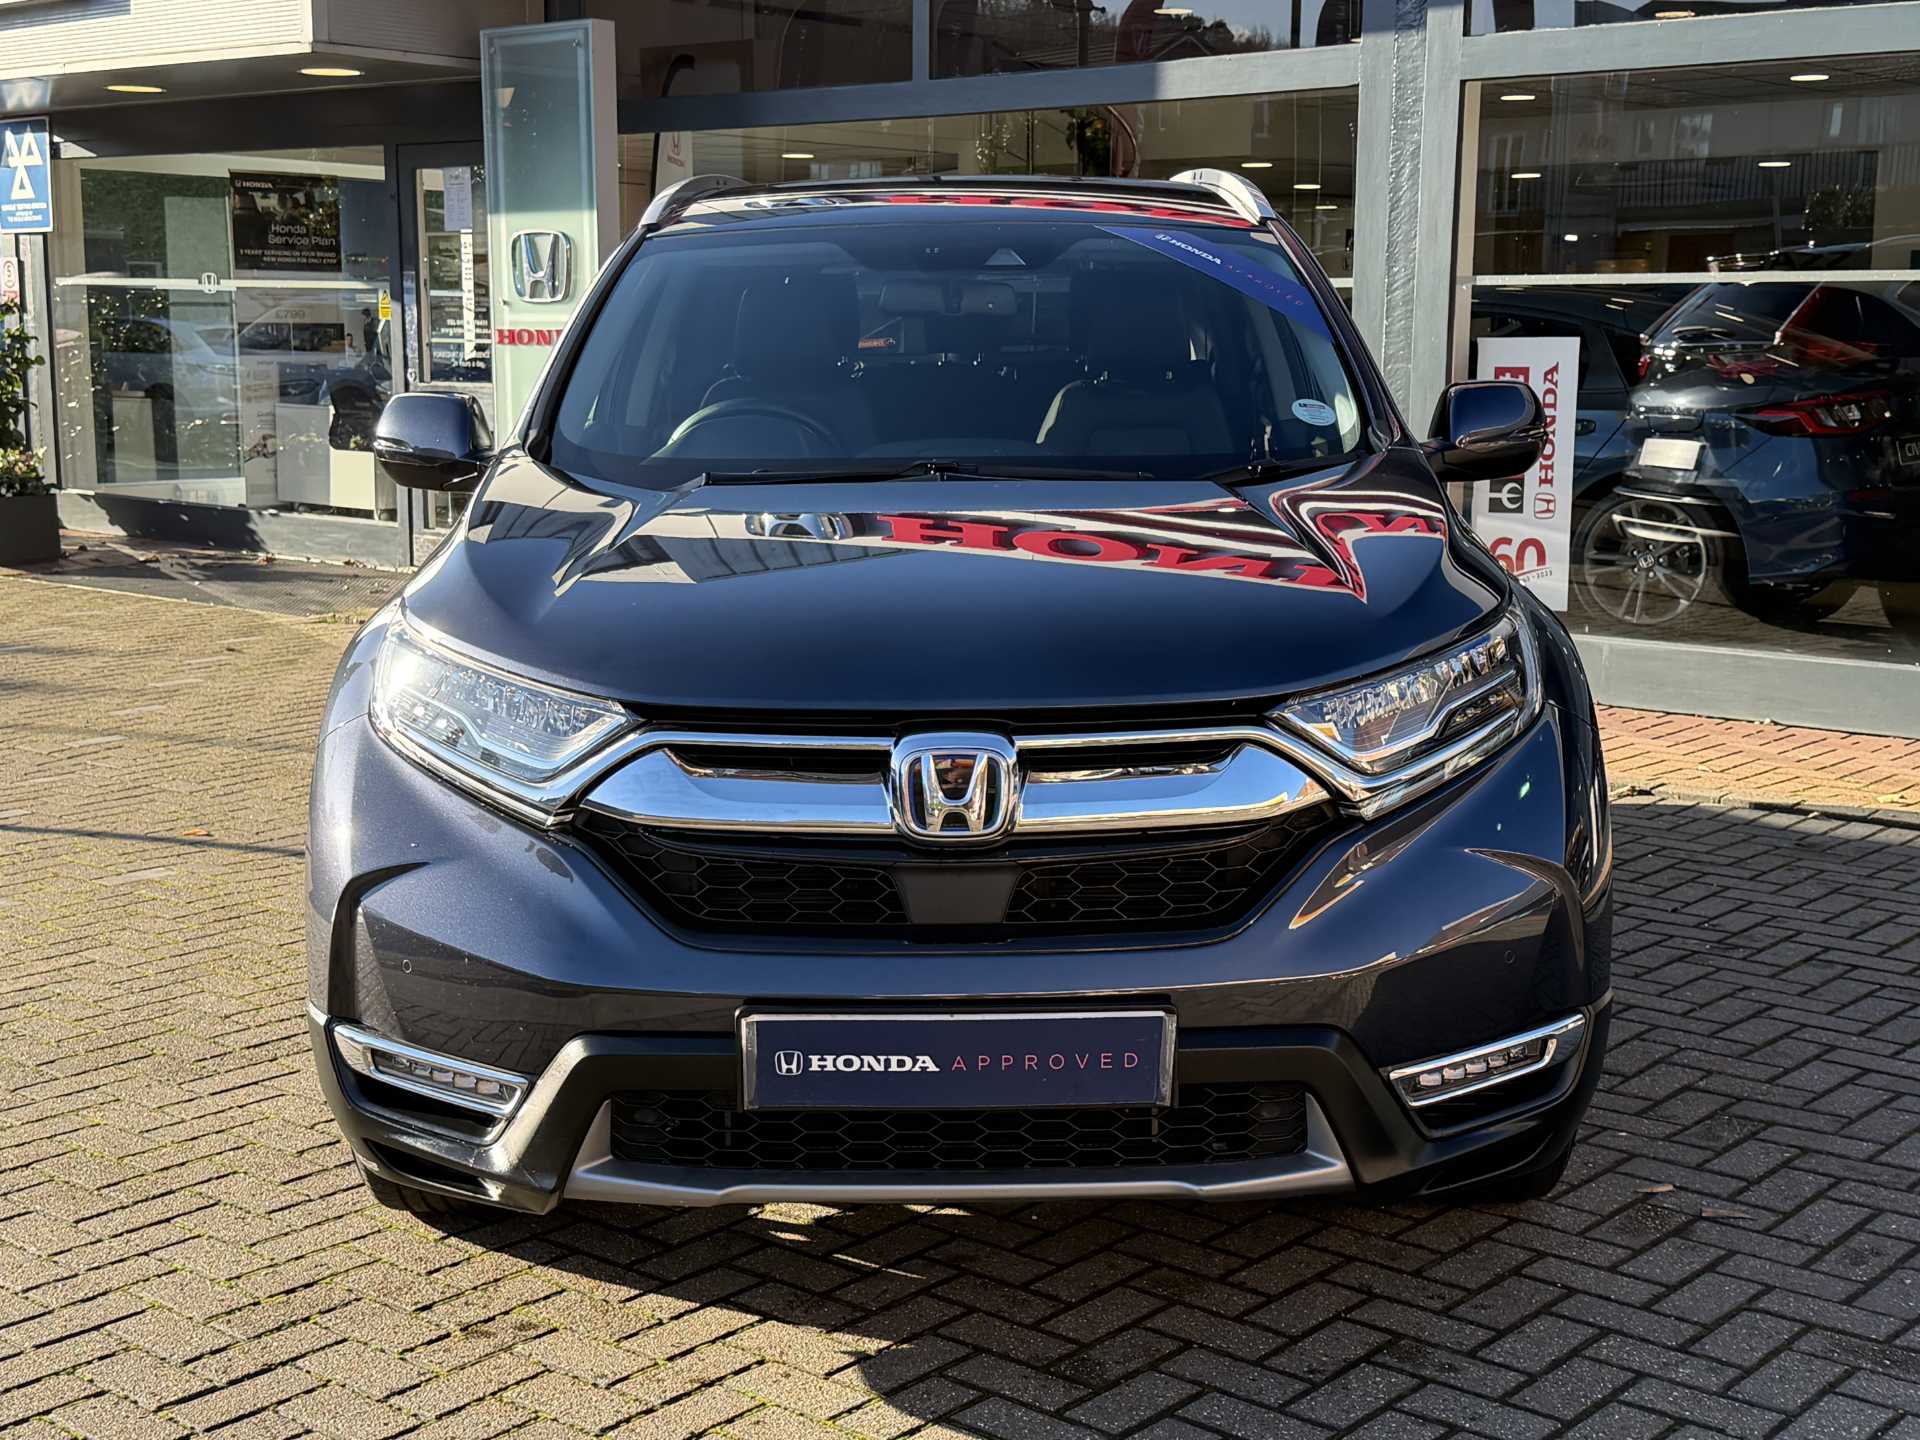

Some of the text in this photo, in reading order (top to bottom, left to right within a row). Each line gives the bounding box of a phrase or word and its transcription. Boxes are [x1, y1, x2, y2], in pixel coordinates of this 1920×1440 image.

[242, 180, 273, 189] HONDA
[271, 223, 307, 234] Honda
[267, 235, 336, 248] Service Plan
[1168, 239, 1222, 265] HONDA
[496, 329, 563, 346] HON
[808, 1052, 1139, 1073] HONDA APPROVED
